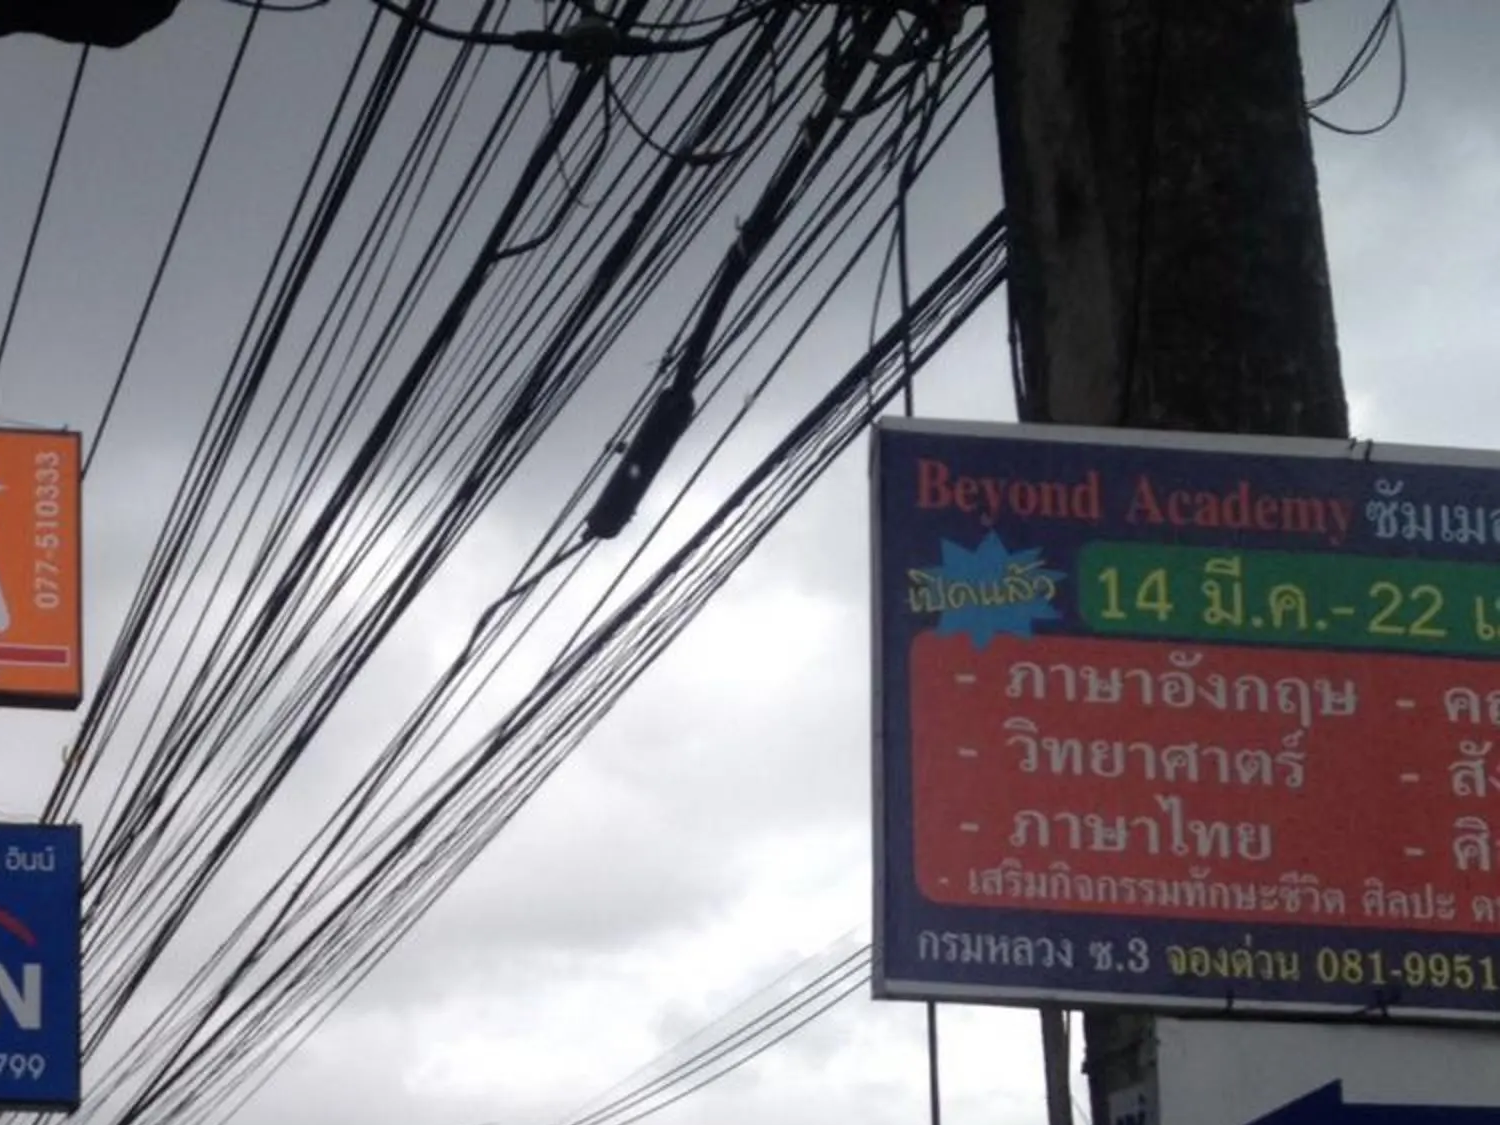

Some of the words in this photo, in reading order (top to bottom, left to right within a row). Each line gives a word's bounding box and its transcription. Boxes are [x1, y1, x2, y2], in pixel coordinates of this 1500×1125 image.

[34, 452, 60, 608] 077-510333
[916, 458, 1100, 525] Beyond
[1125, 475, 1354, 545] Academy
[1097, 566, 1173, 621] 14
[1474, 595, 1500, 641] เ
[1005, 650, 1358, 728] ภาษาอังกฤษ
[1009, 793, 1273, 861] ภาษาไทย
[1453, 816, 1500, 872] ศิ
[1362, 876, 1456, 921] ศิลปะ
[917, 929, 1073, 969] กรมหลวง
[1165, 934, 1300, 981] จองด่วน
